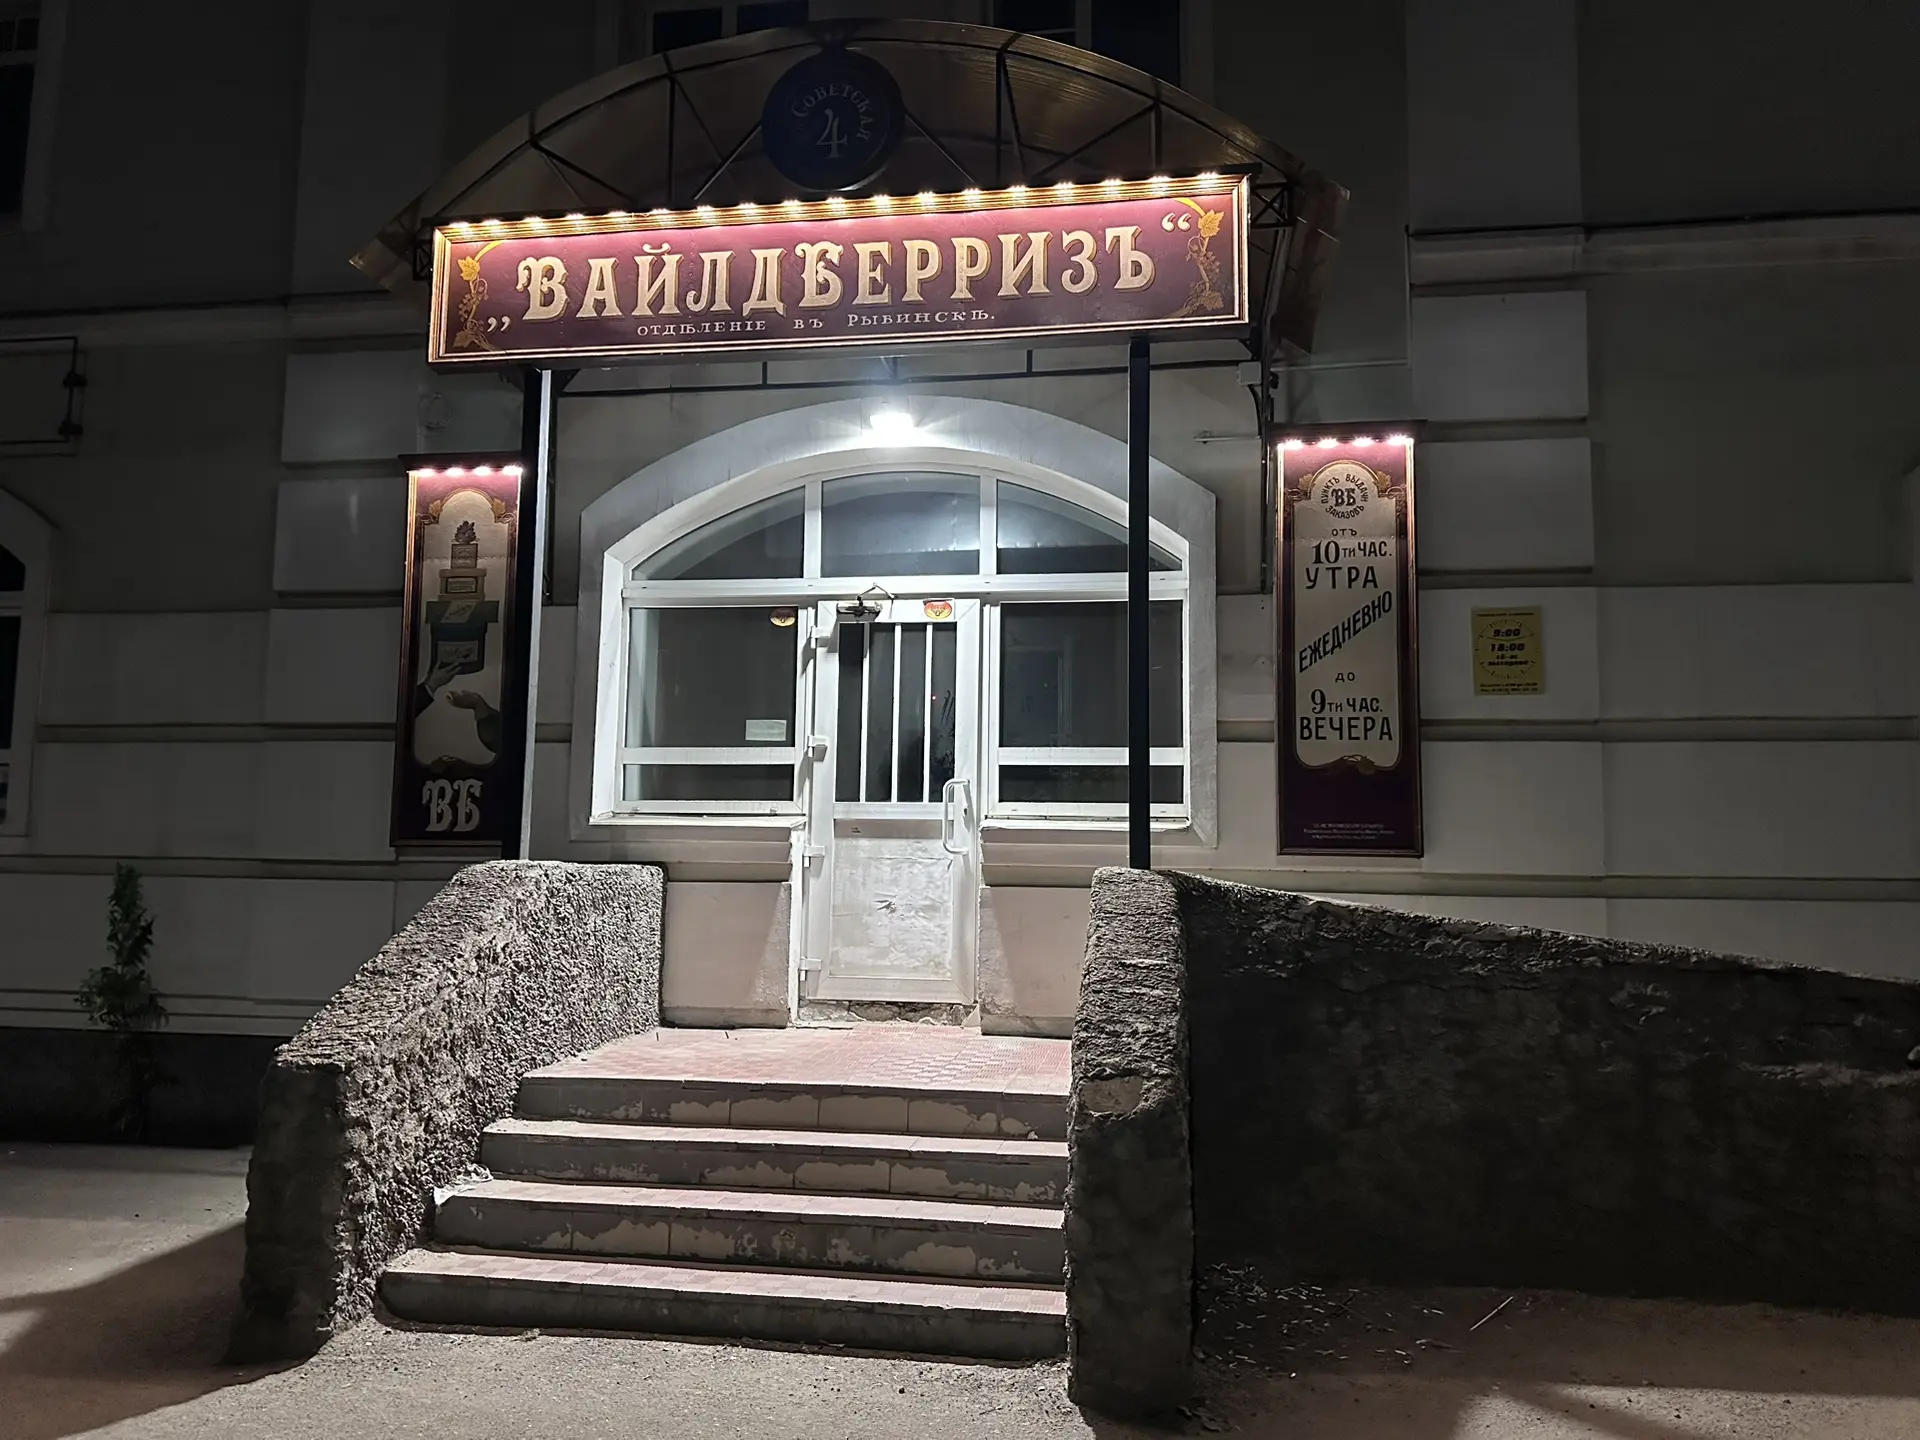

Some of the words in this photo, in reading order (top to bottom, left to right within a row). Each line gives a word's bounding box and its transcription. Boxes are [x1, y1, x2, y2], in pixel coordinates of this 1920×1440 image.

[816, 108, 848, 159] 4
[1320, 476, 1341, 504] ПУНКТЪ
[1325, 505, 1365, 519] ЗАКАЗОВЪ
[1357, 540, 1393, 557] ЧАС.
[1305, 566, 1379, 590] УТРА
[1299, 590, 1393, 674] ЕЖЕДНЕВНО
[1347, 697, 1383, 713] ЧАС.
[1299, 716, 1393, 741] ВЕЧЕРА
[422, 778, 484, 832] ВБ
